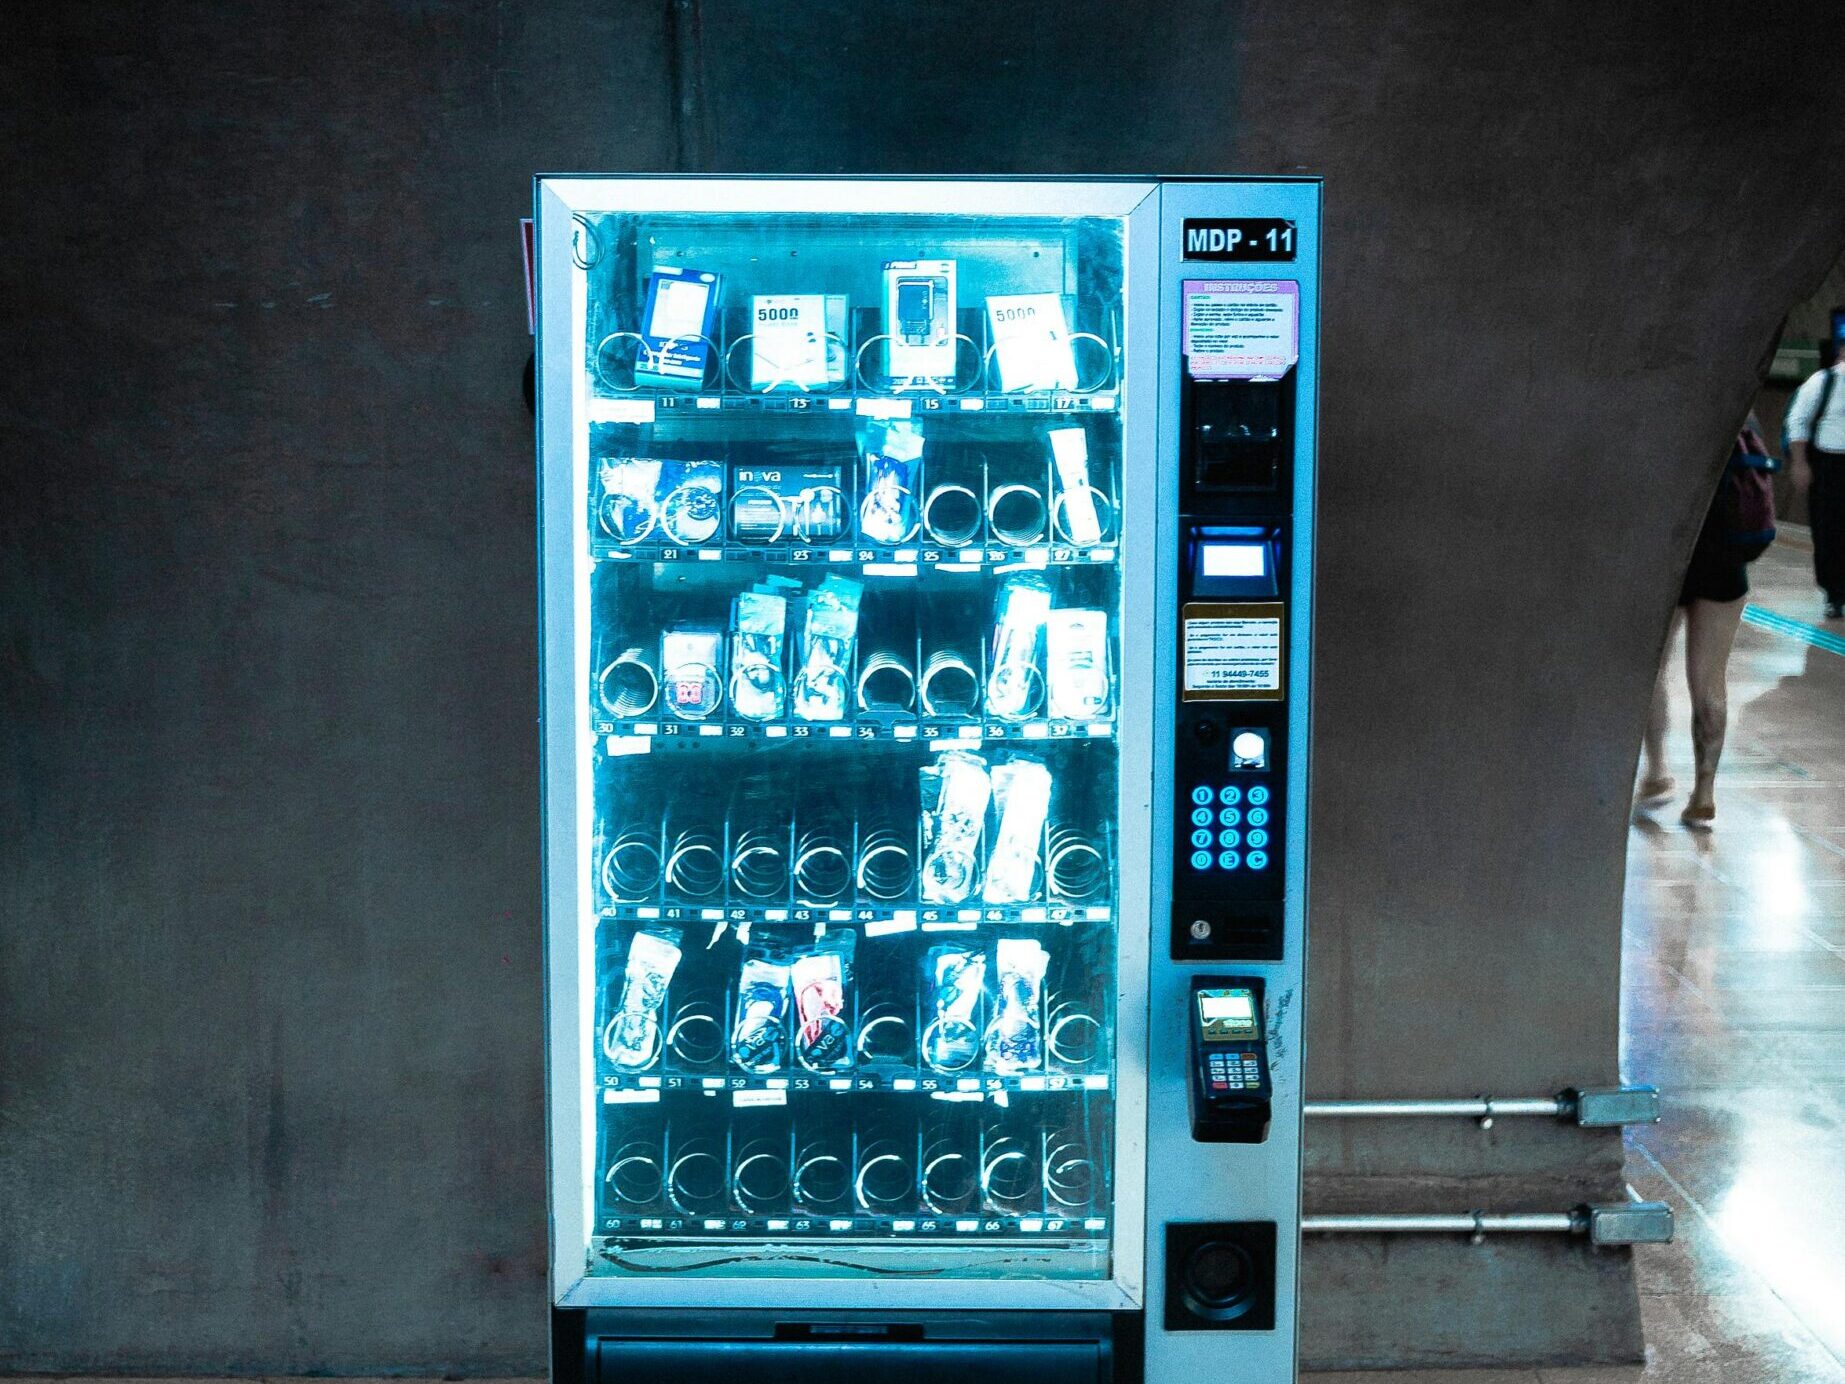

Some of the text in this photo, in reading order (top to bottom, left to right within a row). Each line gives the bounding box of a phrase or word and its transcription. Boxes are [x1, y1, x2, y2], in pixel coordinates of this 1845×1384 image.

[1188, 229, 1242, 252] MDP
[1266, 228, 1293, 252] 11
[758, 308, 799, 321] 5000
[662, 398, 674, 407] 11
[925, 399, 938, 409] 15
[664, 550, 677, 559] 21
[665, 725, 678, 734] 31
[730, 726, 744, 736] 32
[793, 726, 808, 736] 33
[923, 727, 938, 737] 35
[989, 727, 1003, 737] 36
[667, 909, 680, 918] 41
[731, 910, 745, 919] 42
[794, 910, 810, 920] 43
[604, 1076, 618, 1086] 50
[668, 1078, 681, 1087] 51
[731, 1079, 746, 1088] 52
[795, 1079, 809, 1088] 53
[858, 1079, 873, 1089] 54
[922, 1079, 937, 1089] 55
[606, 1219, 620, 1228] 60
[670, 1220, 682, 1229] 61
[732, 1221, 746, 1230] 62
[796, 1220, 810, 1230] 63
[922, 1221, 936, 1230] 65
[985, 1221, 999, 1230] 66
